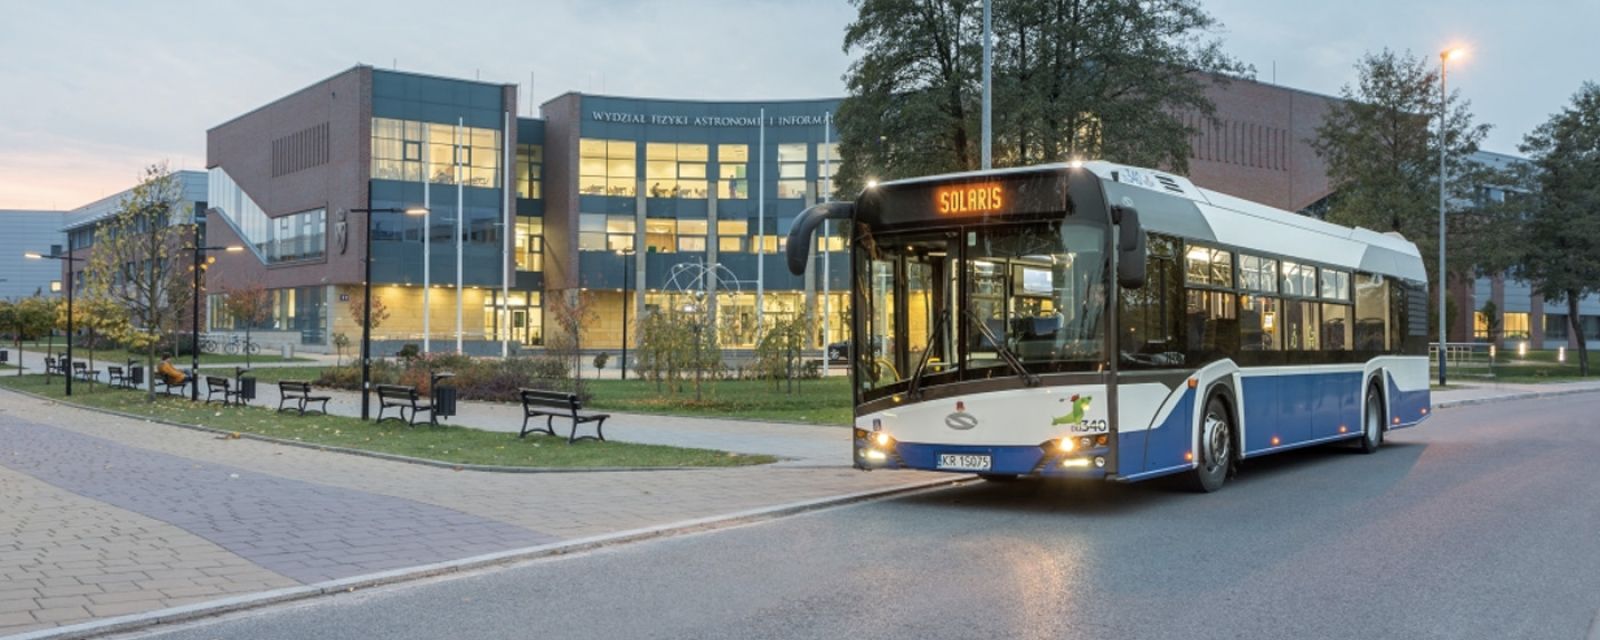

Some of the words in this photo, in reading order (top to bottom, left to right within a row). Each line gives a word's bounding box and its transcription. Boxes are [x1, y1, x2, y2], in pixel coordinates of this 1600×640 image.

[652, 114, 688, 125] FIZYKI
[939, 187, 1002, 213] SOLARIS
[942, 455, 956, 466] KR
